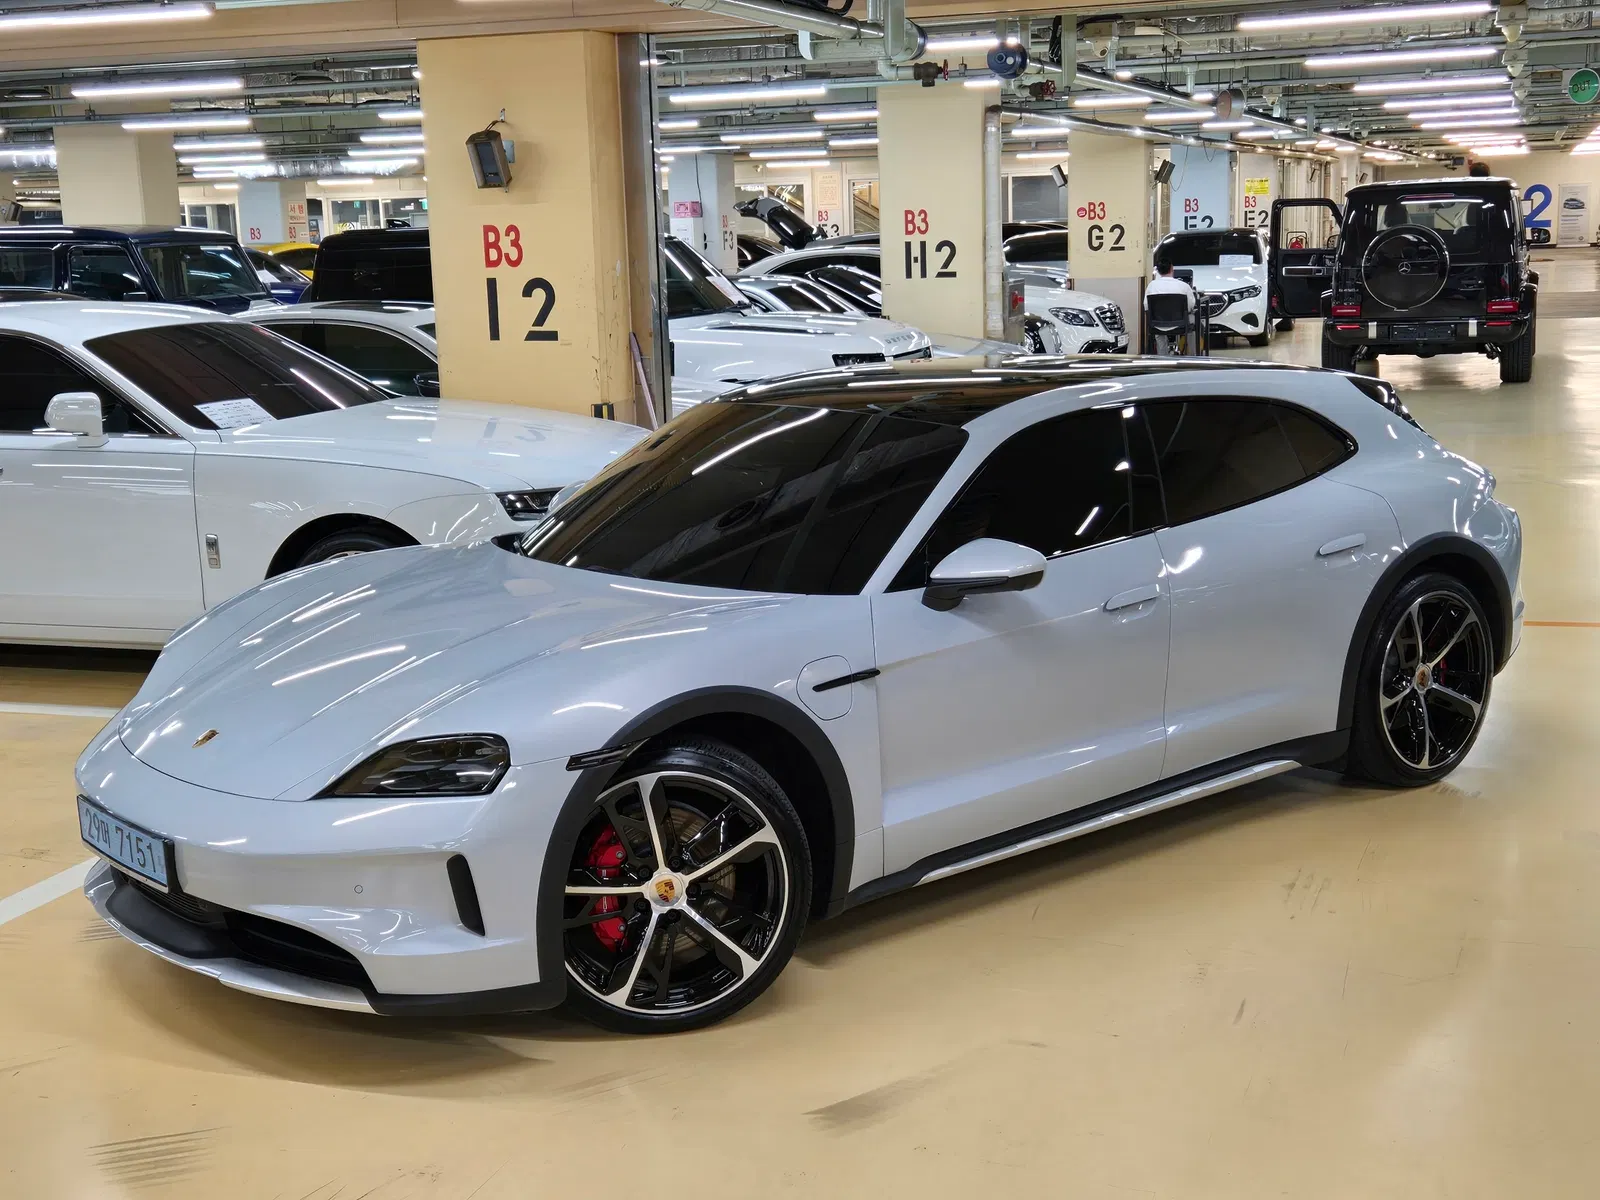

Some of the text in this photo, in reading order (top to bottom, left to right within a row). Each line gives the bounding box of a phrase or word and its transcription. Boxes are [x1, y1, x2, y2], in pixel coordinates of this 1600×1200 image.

[1572, 80, 1590, 93] OUT
[1088, 201, 1106, 220] B3
[1184, 198, 1199, 213] B3
[1244, 196, 1257, 208] B3
[1524, 184, 1552, 228] 2
[818, 210, 829, 222] B3
[904, 209, 929, 235] B3
[1244, 210, 1269, 228] E2
[250, 228, 262, 240] B3
[1088, 223, 1126, 252] G2
[483, 224, 524, 268] B3
[904, 240, 957, 279] H2
[115, 826, 156, 873] 7151
